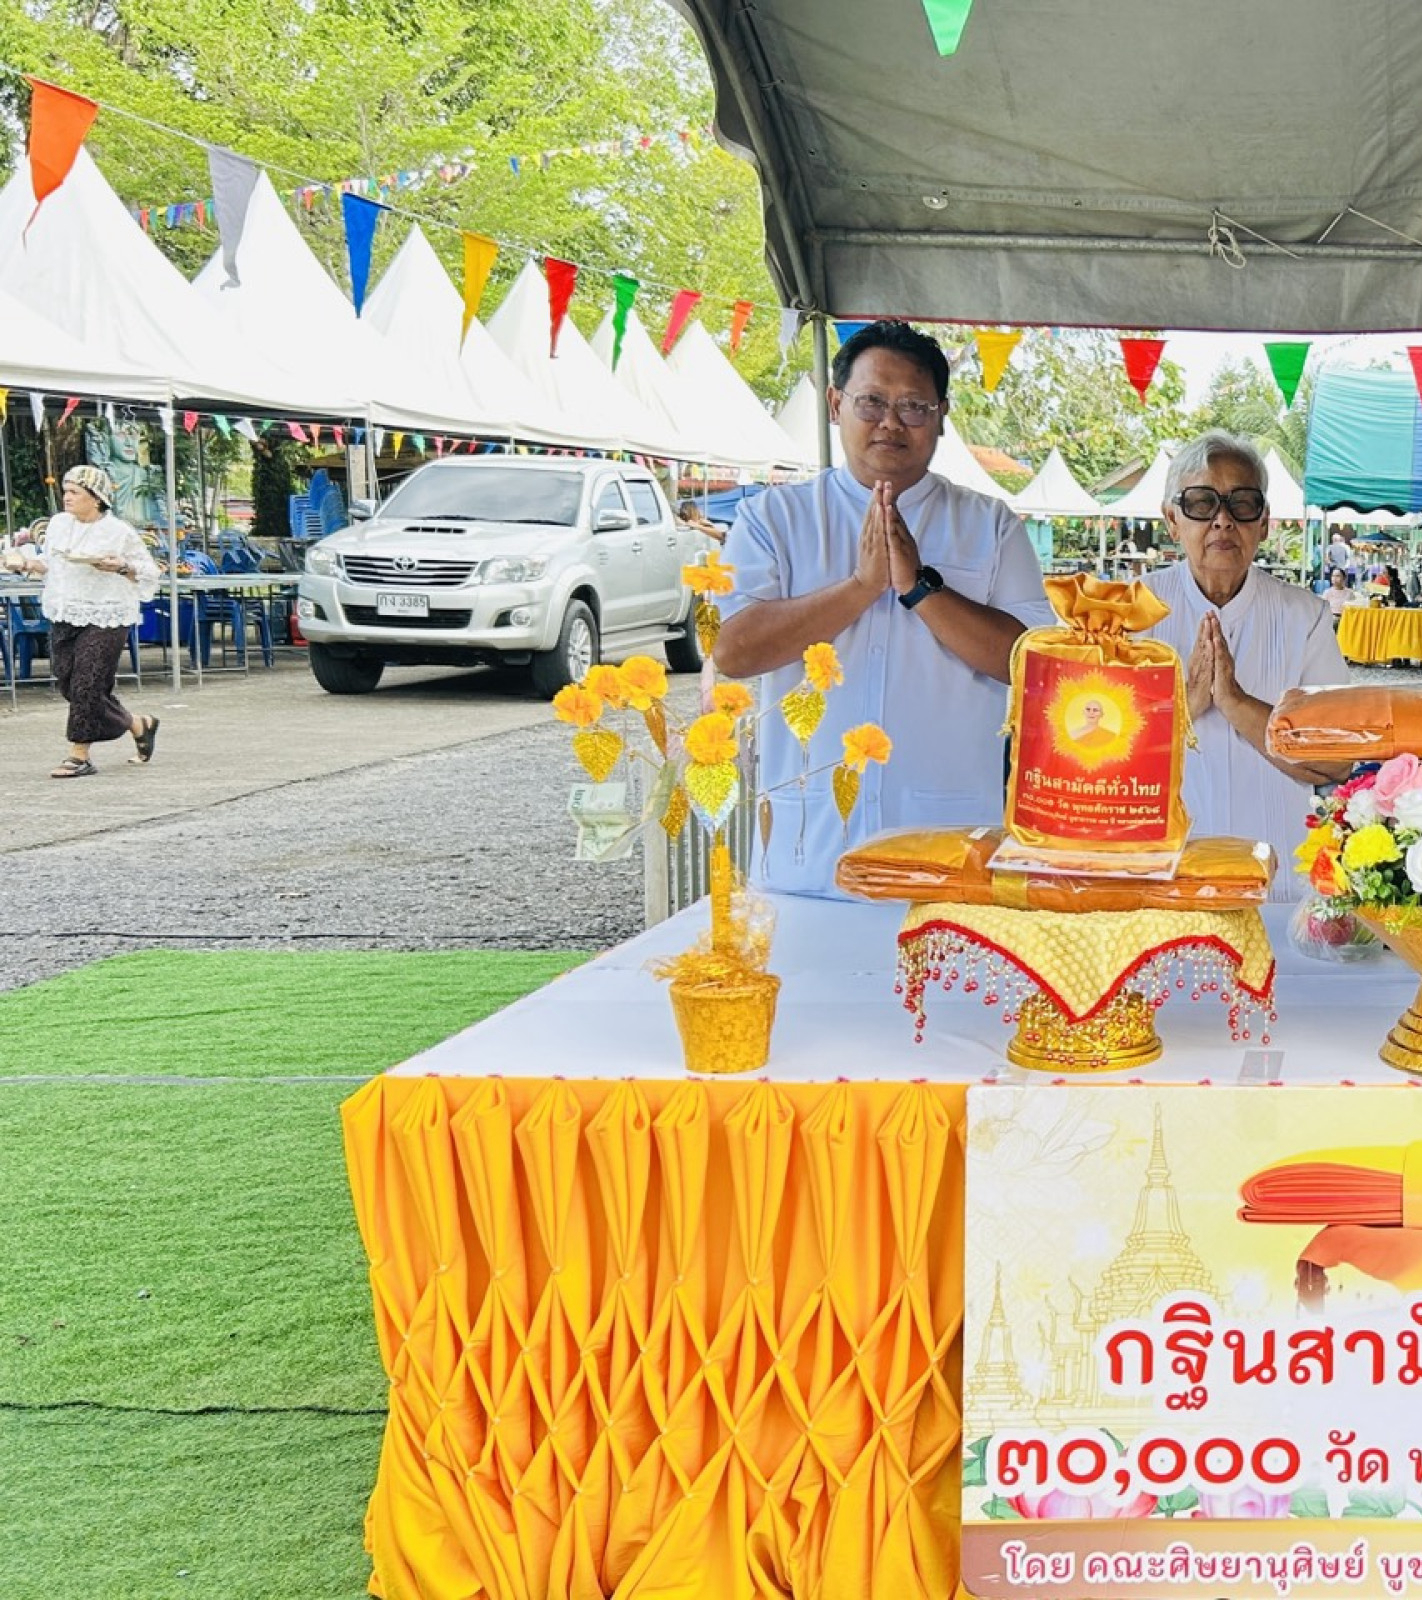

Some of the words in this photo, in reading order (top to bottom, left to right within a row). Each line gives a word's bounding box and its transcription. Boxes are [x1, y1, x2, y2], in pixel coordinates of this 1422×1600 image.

[1024, 768, 1161, 797] กฐินสามัคคีทั่วไทย
[997, 1437, 1301, 1497] ๓๐,๐๐๐
[1325, 1429, 1390, 1484] วัด
[1005, 1546, 1072, 1581] โดย
[1087, 1543, 1365, 1591] คณะศิษยานุศิษย์
